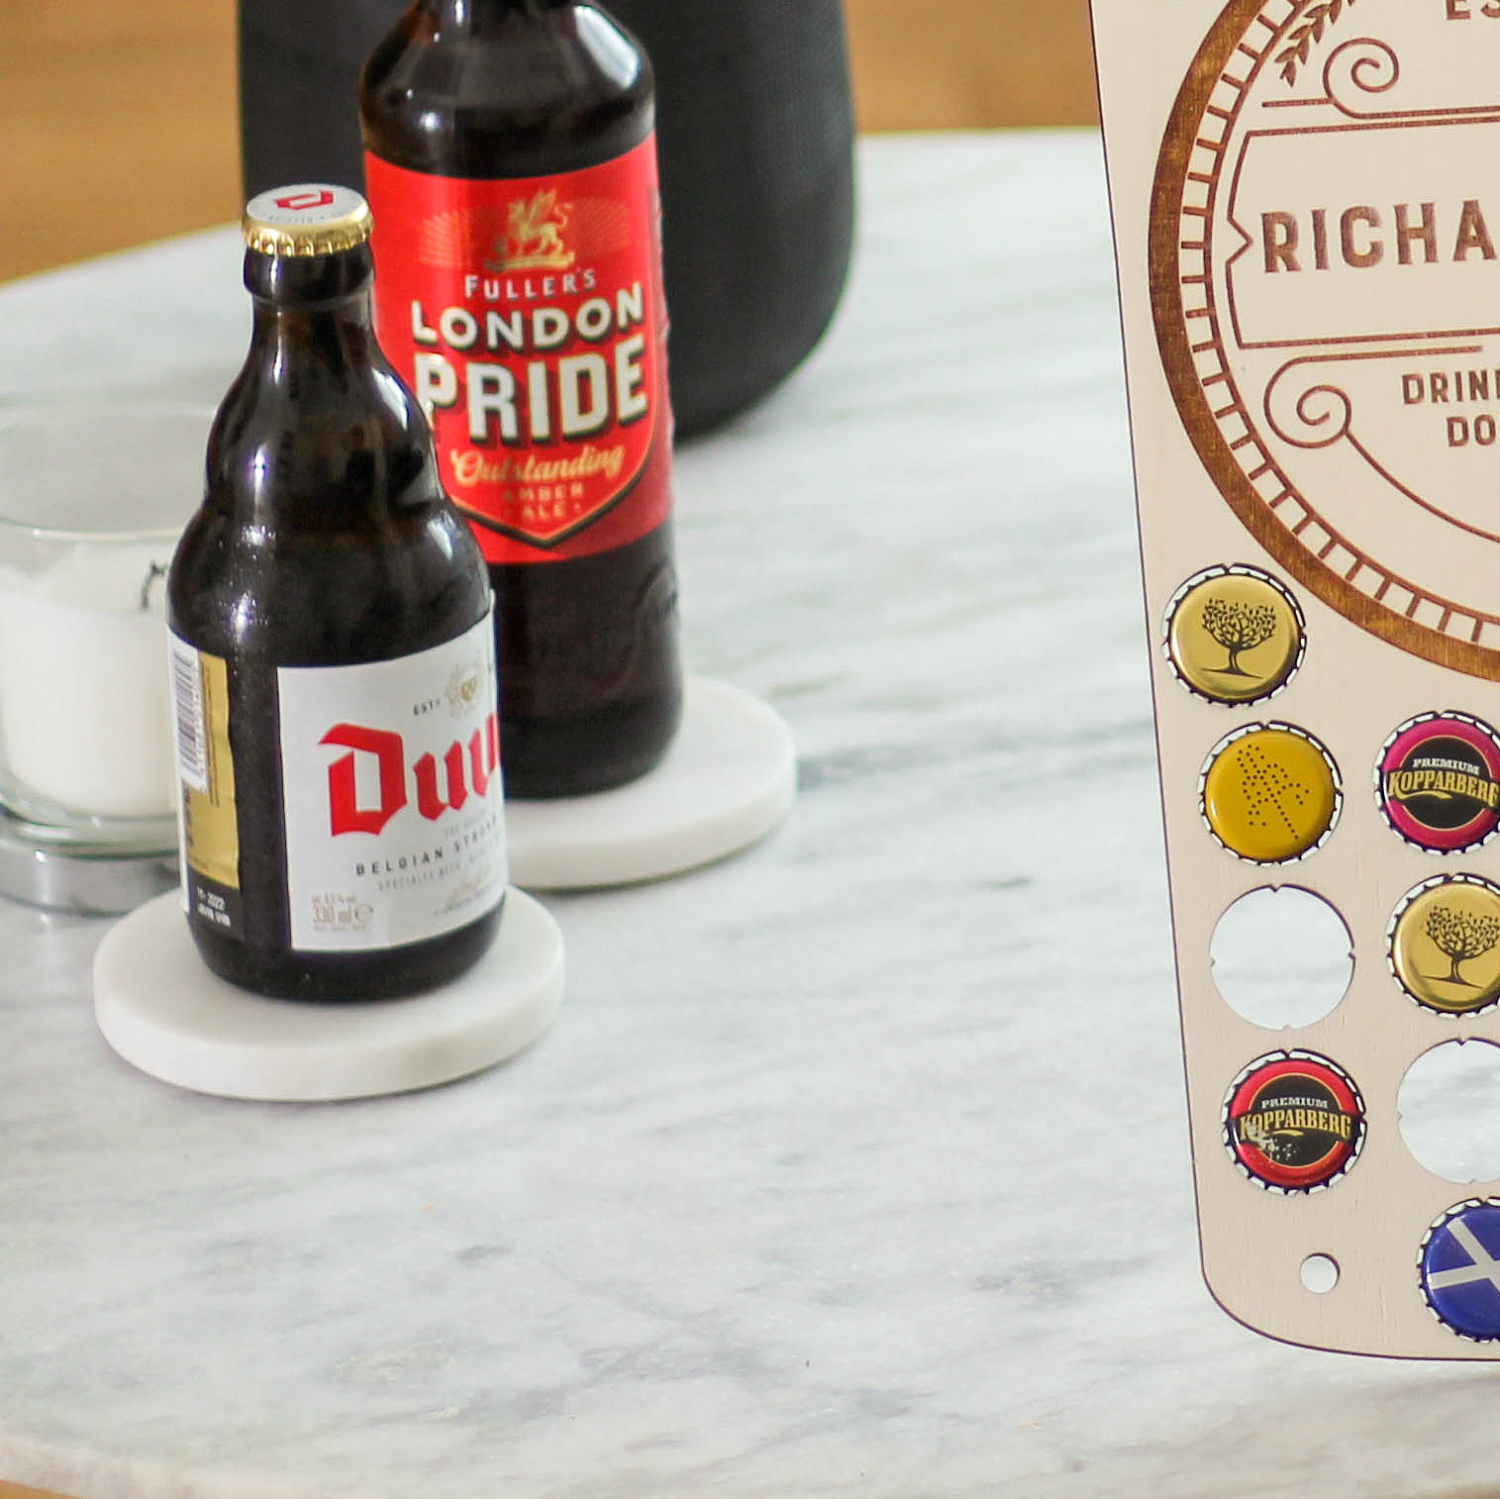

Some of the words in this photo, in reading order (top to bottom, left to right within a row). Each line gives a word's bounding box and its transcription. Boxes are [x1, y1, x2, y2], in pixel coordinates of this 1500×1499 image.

[464, 268, 596, 300] FULLER'S
[411, 281, 644, 351] LONDON
[414, 333, 649, 442] PRIDE
[451, 444, 625, 487] Outstanding
[1412, 758, 1480, 775] PREMIUM
[1388, 770, 1500, 808] KOPPARBERG
[356, 846, 443, 877] BELGIAN
[1261, 1097, 1328, 1109] PREMIUM
[1240, 1108, 1351, 1142] KOPPARBERG
